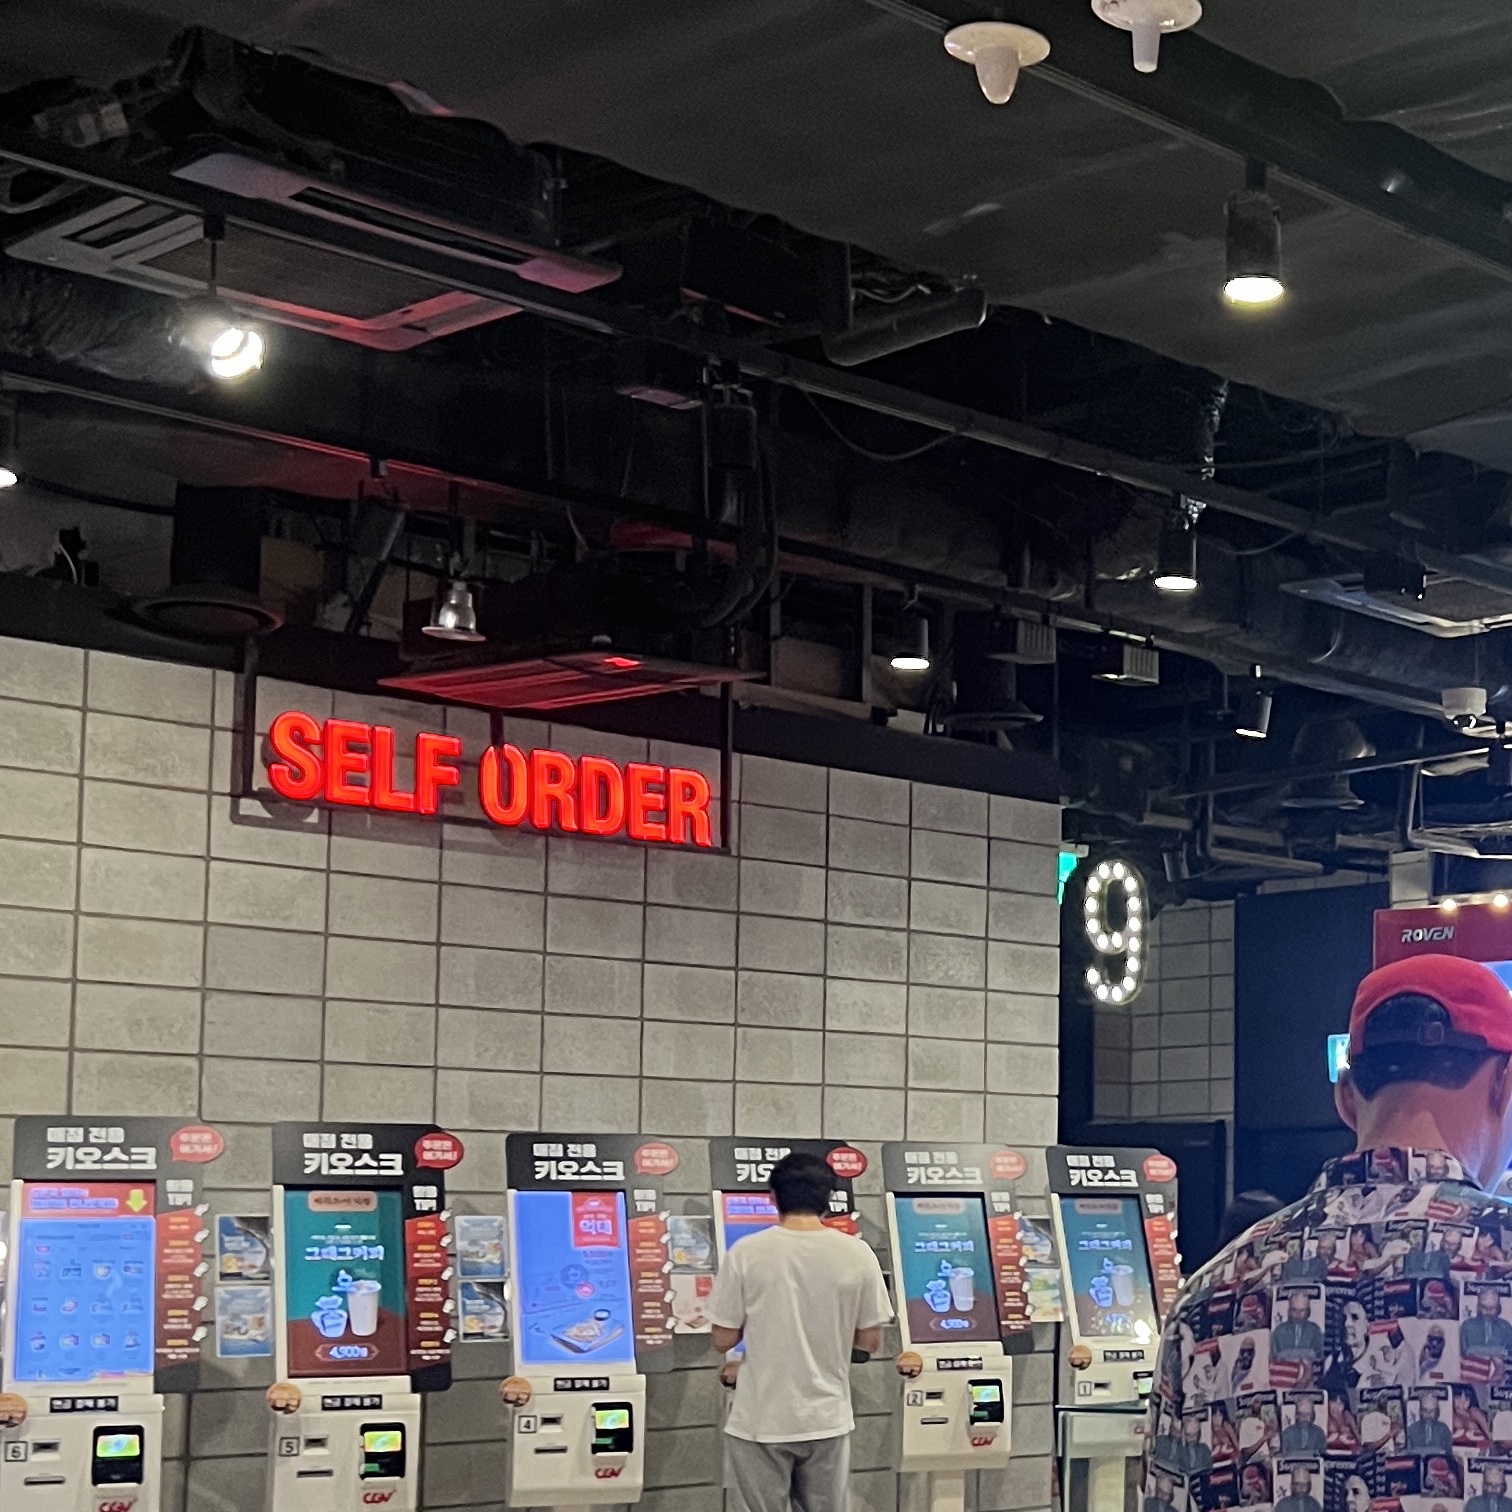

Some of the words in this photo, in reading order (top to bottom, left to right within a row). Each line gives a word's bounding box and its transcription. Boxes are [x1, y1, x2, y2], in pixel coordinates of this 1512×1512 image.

[268, 710, 462, 815] SELF
[479, 743, 714, 847] ORDER
[1083, 859, 1150, 1005] 9
[1401, 925, 1455, 943] ROVEN
[46, 1146, 157, 1170] 키오스크
[303, 1152, 404, 1176] 키오스크
[534, 1160, 625, 1181] 키오스크
[907, 1166, 983, 1185] 키오스크
[1069, 1169, 1139, 1187] 키오스크
[594, 1467, 622, 1479] CGV
[362, 1491, 393, 1505] CGV
